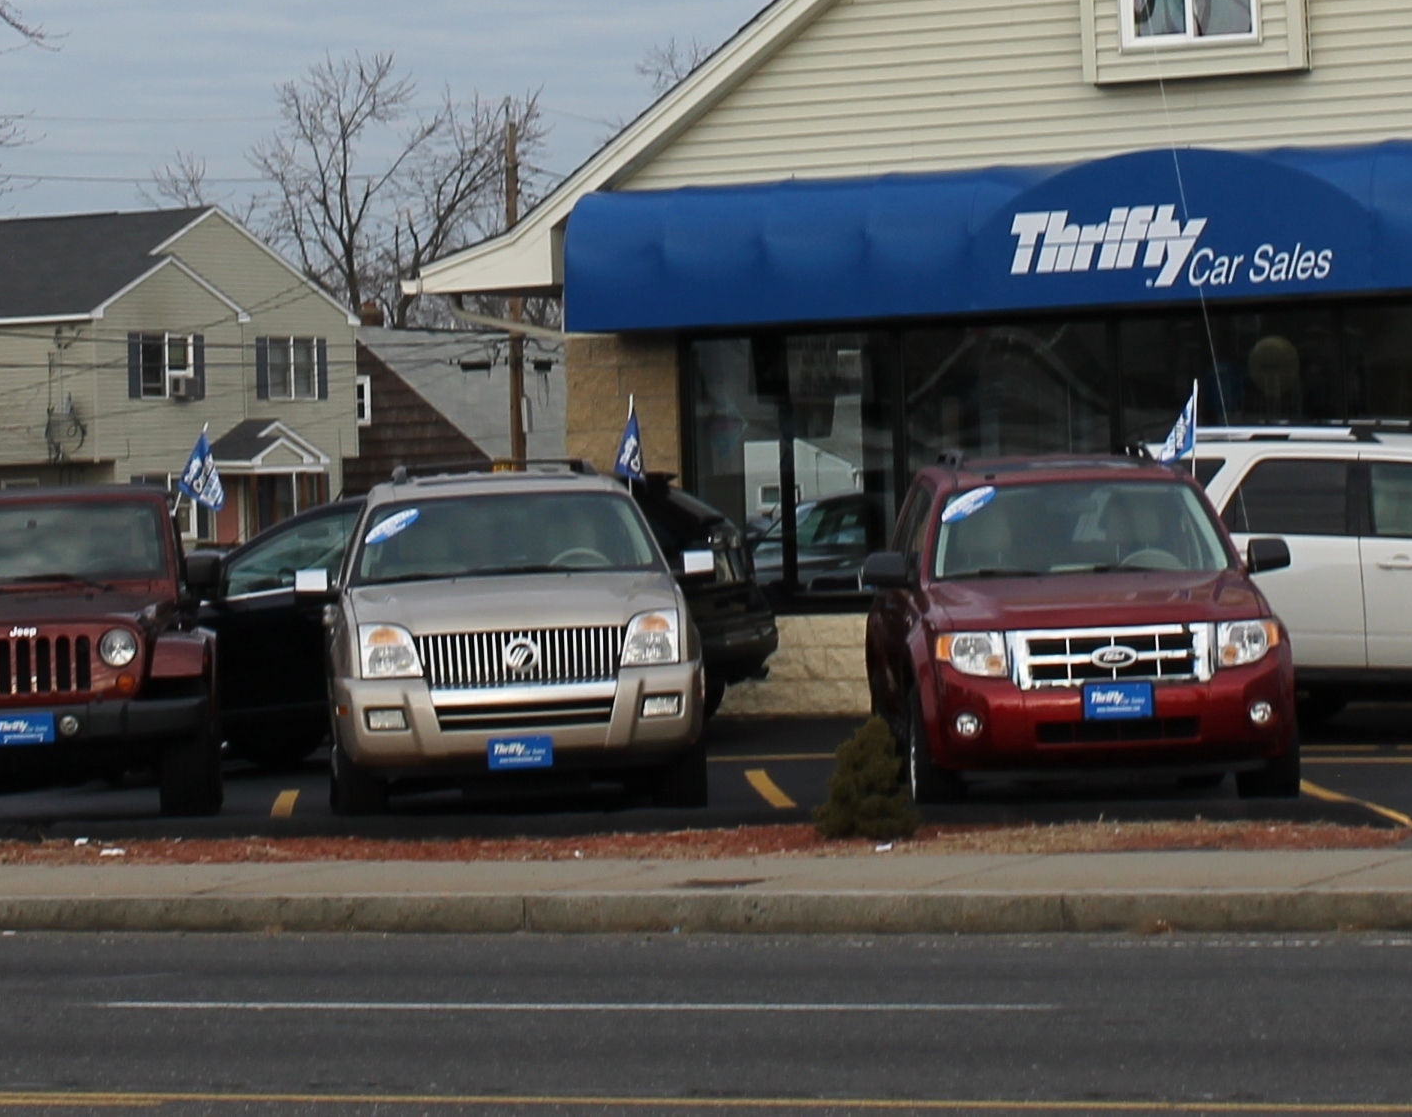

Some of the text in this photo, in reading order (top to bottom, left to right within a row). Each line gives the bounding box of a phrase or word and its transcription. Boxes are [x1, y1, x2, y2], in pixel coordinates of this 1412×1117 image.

[1010, 204, 1208, 288] Thrifty
[1189, 242, 1333, 287] Car Sales
[9, 625, 37, 638] Jeep
